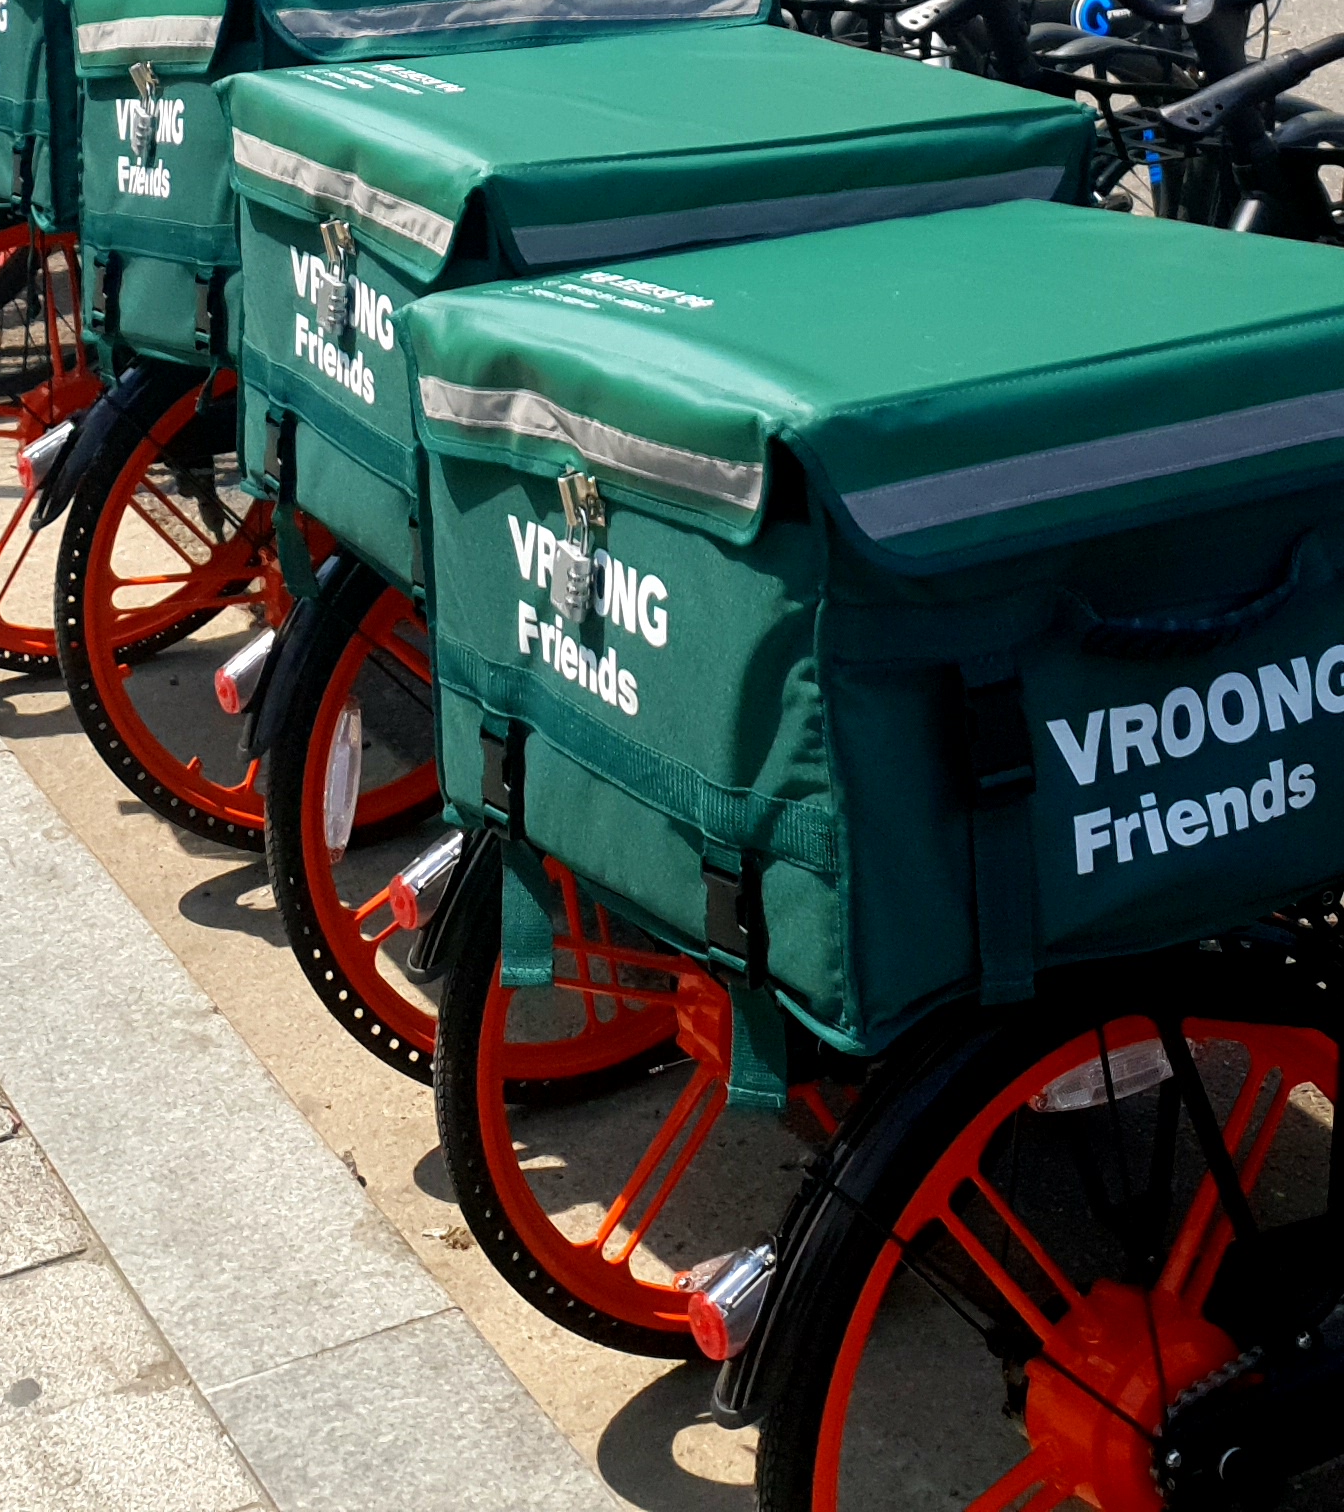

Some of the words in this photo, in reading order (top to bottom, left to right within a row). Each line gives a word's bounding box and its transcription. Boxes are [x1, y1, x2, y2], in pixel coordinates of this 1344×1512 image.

[117, 155, 171, 199] Friends
[290, 245, 395, 351] VRONG
[295, 312, 376, 405] Friends
[507, 514, 669, 648] VRONG
[517, 599, 640, 717] Friends
[1073, 758, 1316, 875] Friends
